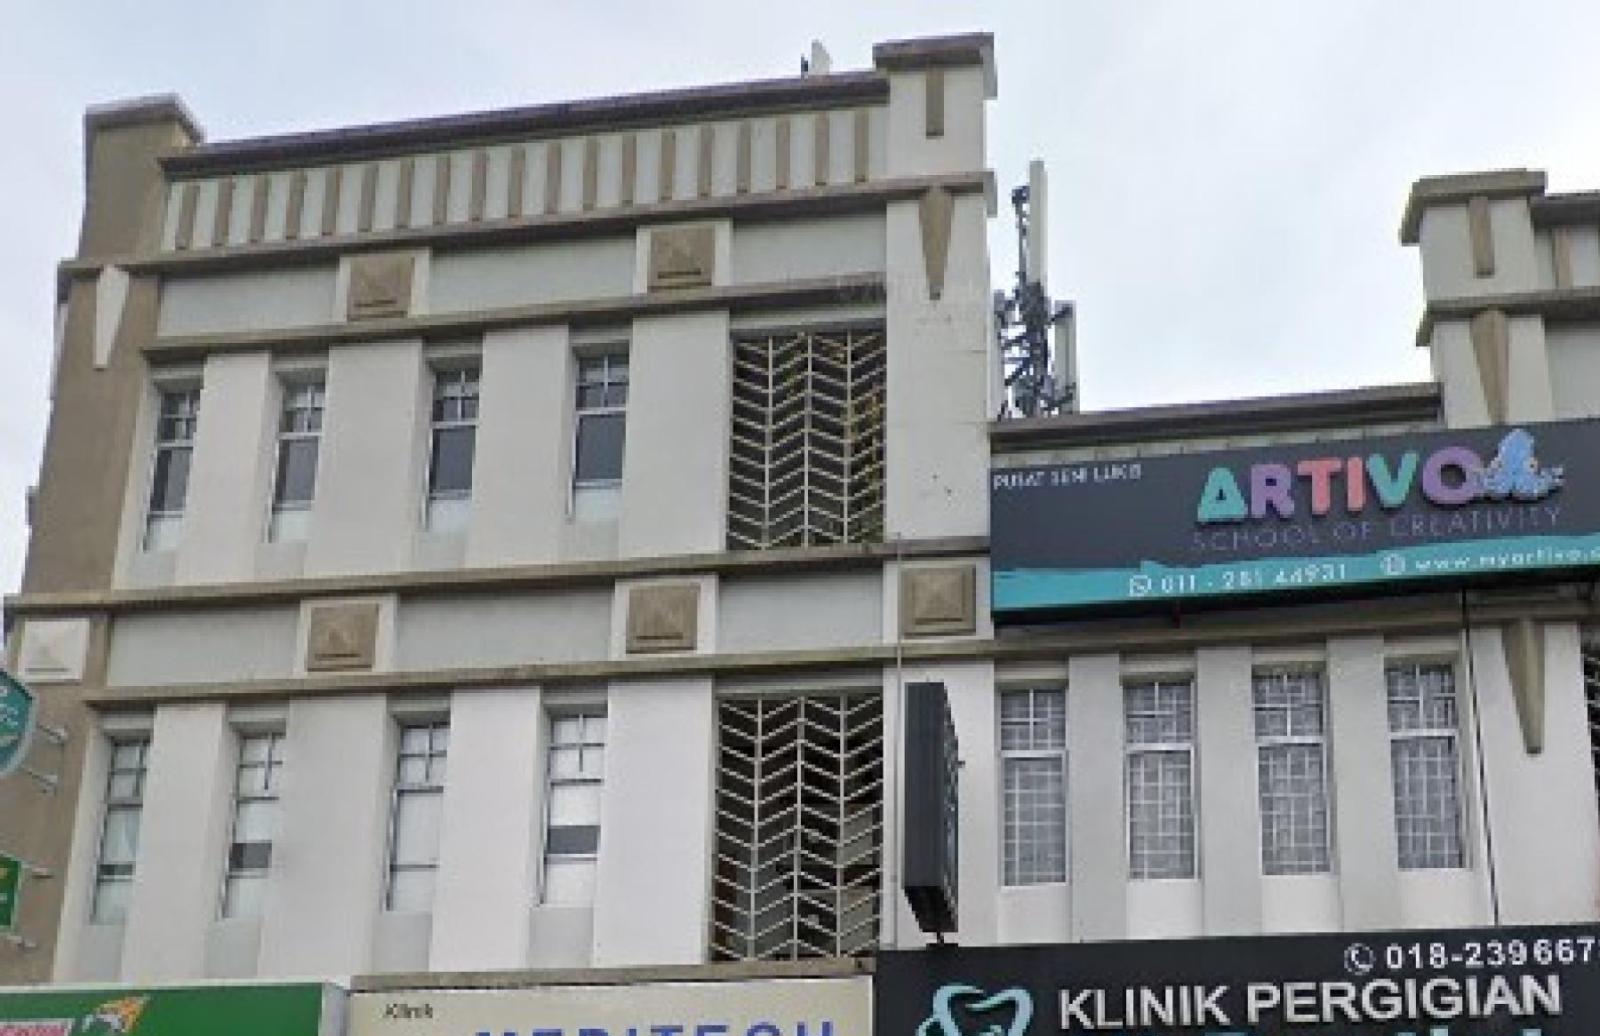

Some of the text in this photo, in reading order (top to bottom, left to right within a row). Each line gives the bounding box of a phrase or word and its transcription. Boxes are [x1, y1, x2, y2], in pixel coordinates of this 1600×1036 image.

[1196, 445, 1484, 522] ARTIVO
[1192, 505, 1562, 552] SCHOOL OF CREATIVITY
[1058, 973, 1564, 1030] KLINIK PERGIGIAN
